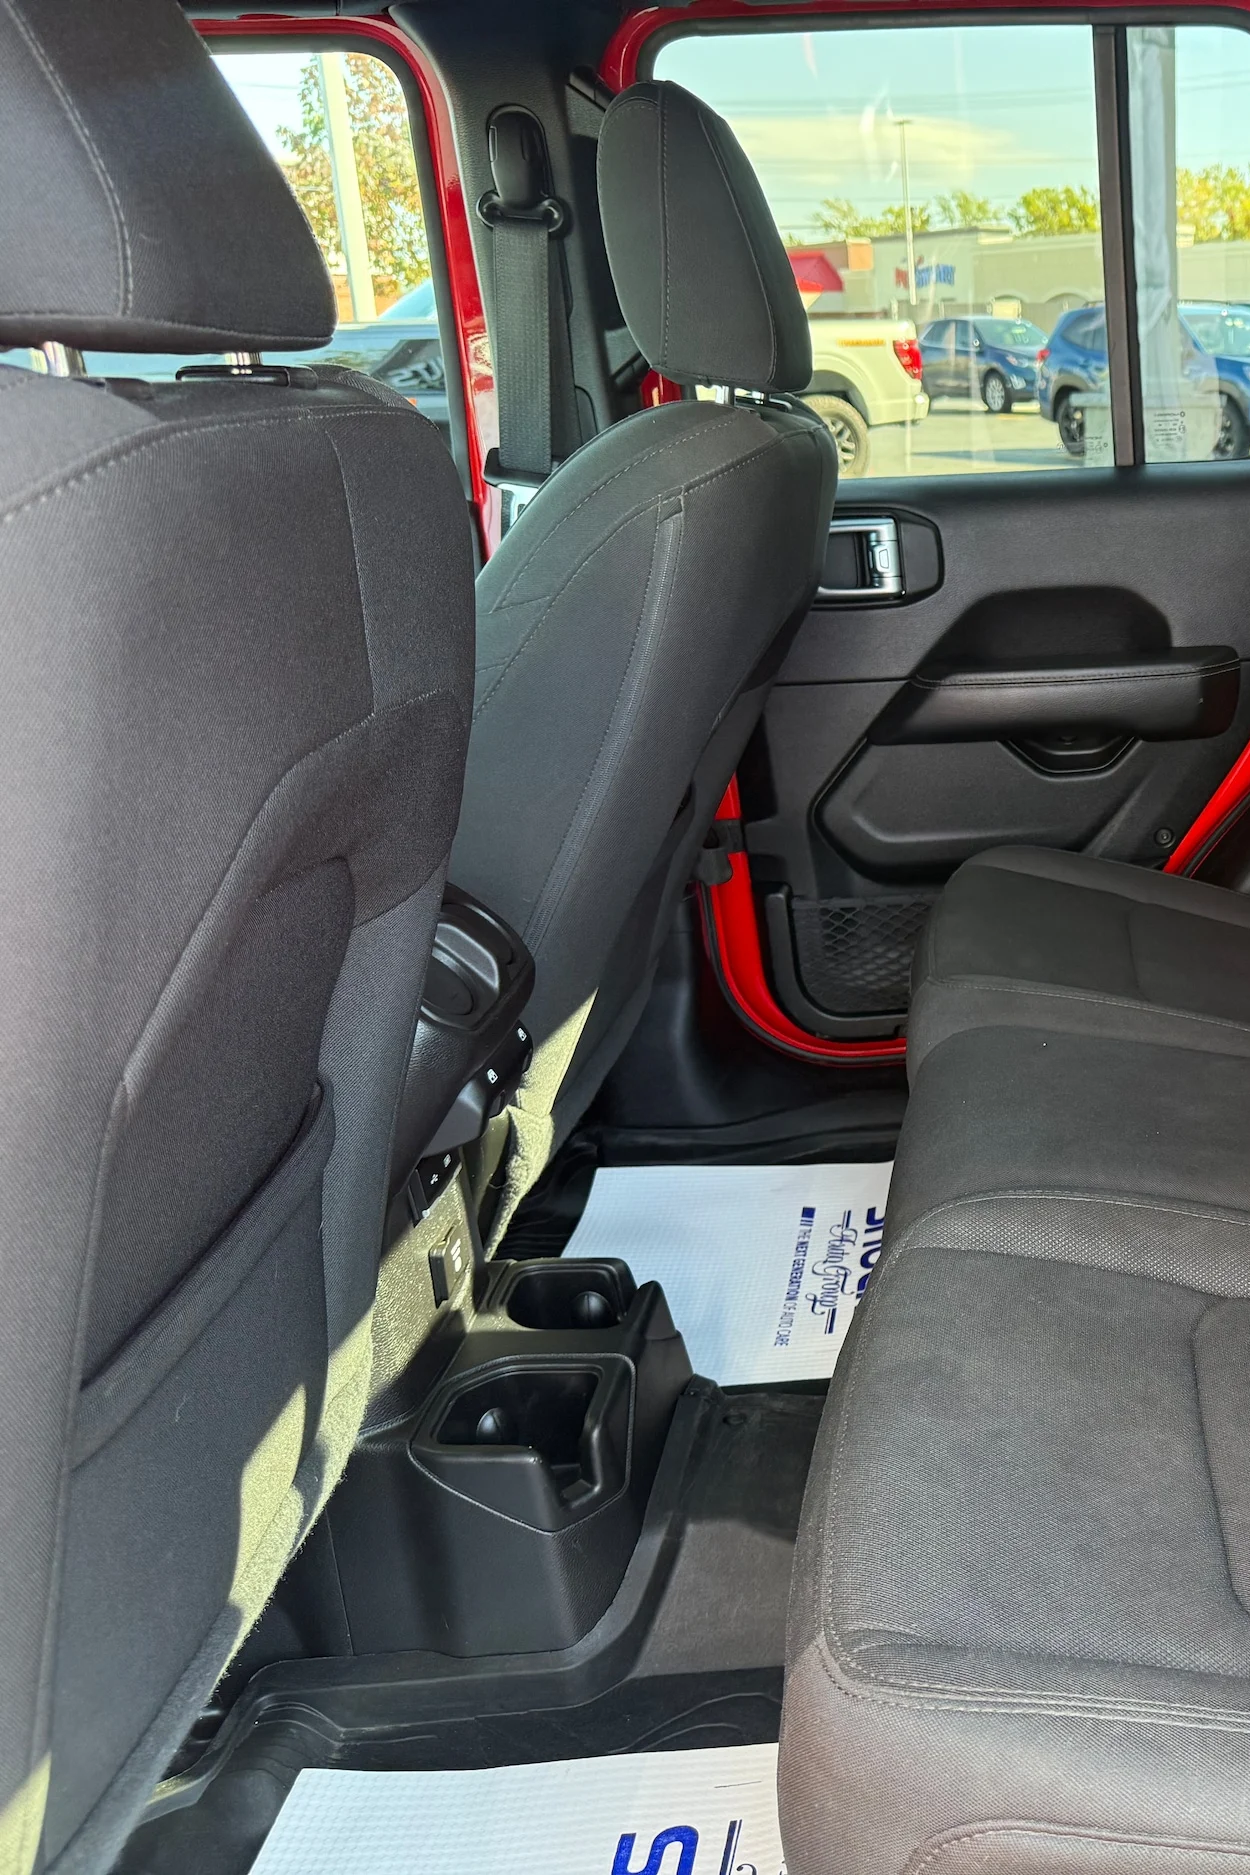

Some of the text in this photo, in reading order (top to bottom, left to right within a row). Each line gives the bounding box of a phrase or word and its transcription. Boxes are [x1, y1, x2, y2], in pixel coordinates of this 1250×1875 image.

[774, 1227, 812, 1346] THE NEXT GENERATION OF AUTO CARE
[805, 1224, 858, 1315] Auto Group
